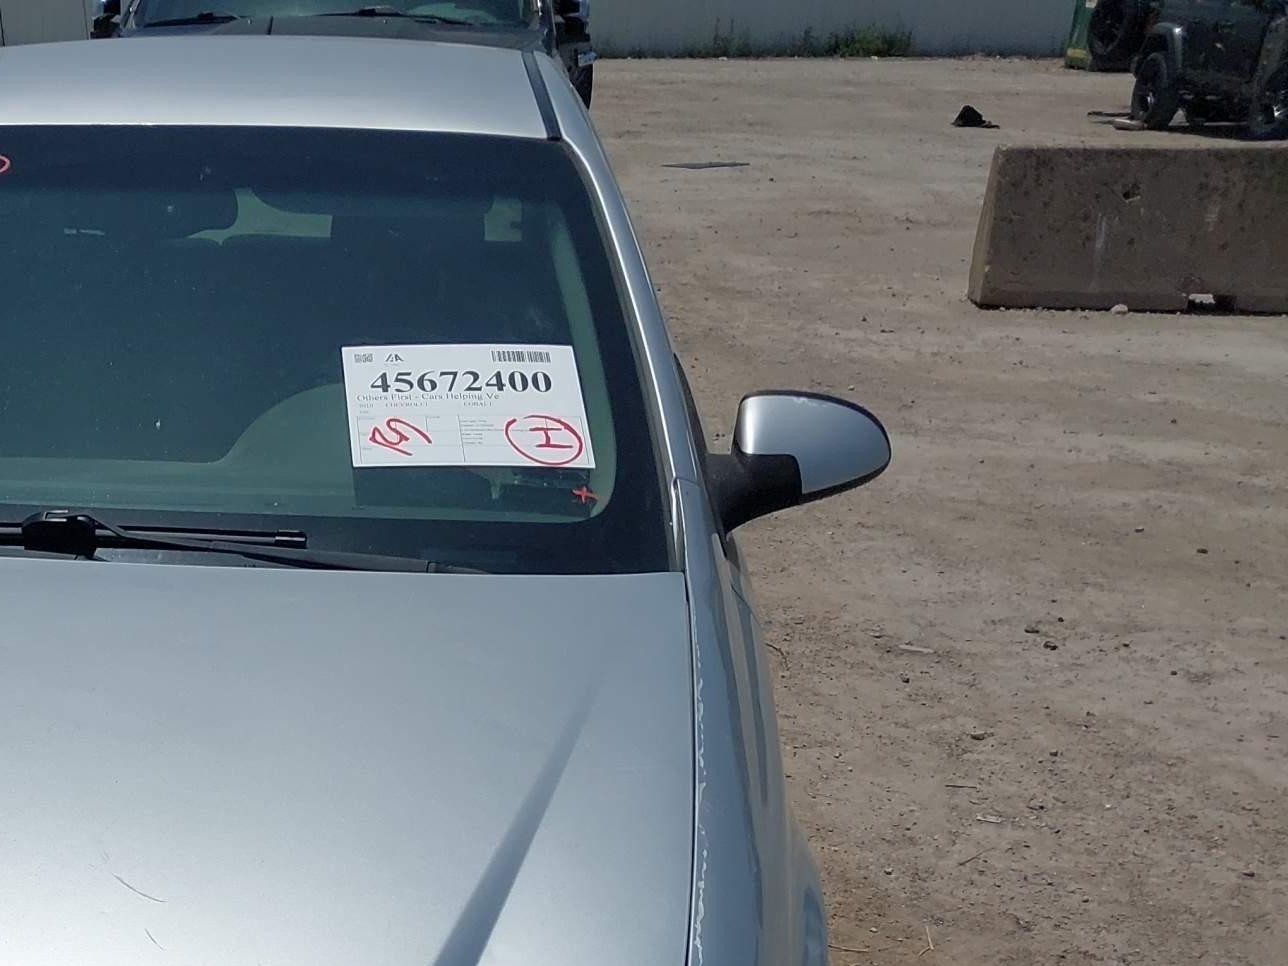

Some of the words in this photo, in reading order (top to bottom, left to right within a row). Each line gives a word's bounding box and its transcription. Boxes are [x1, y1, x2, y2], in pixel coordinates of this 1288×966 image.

[370, 370, 552, 393] 45672400
[356, 393, 388, 401] Others
[391, 393, 413, 401] First
[421, 393, 443, 401] Cars
[445, 392, 483, 402] Helping
[486, 392, 500, 401] Ve
